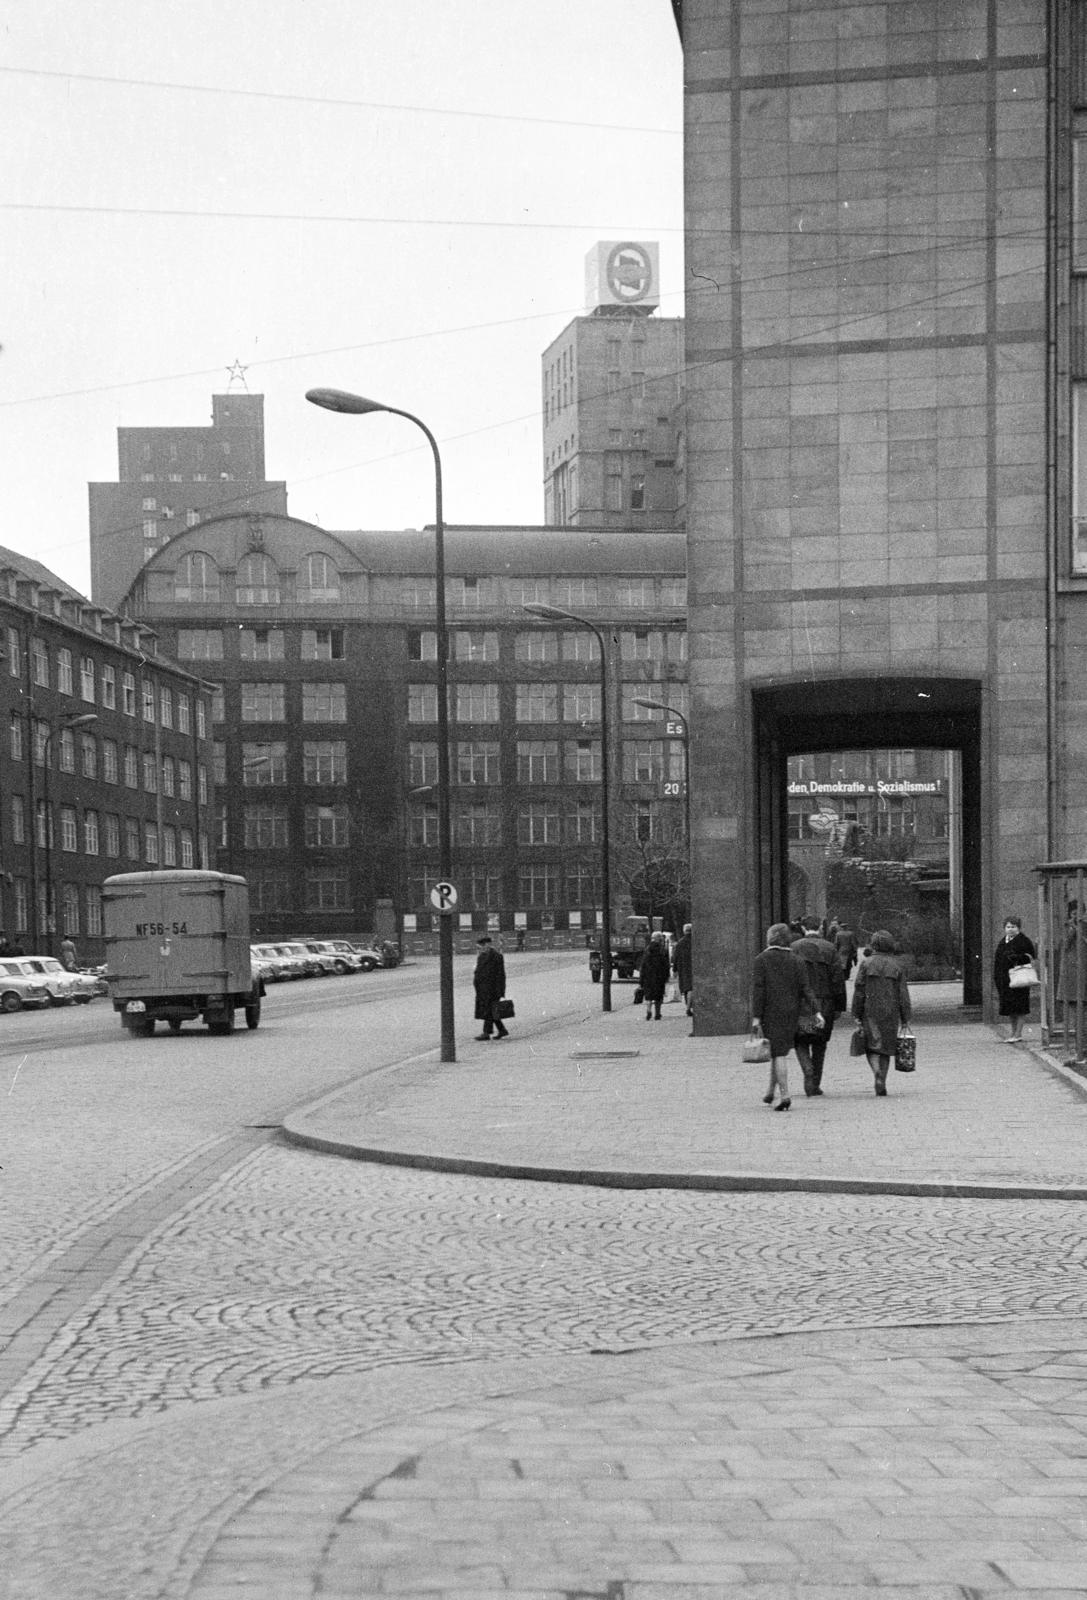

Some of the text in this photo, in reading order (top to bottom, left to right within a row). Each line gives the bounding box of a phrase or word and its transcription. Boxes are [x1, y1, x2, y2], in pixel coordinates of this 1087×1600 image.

[666, 722, 683, 734] Es
[664, 782, 679, 795] 20
[810, 780, 866, 793] Demokratie
